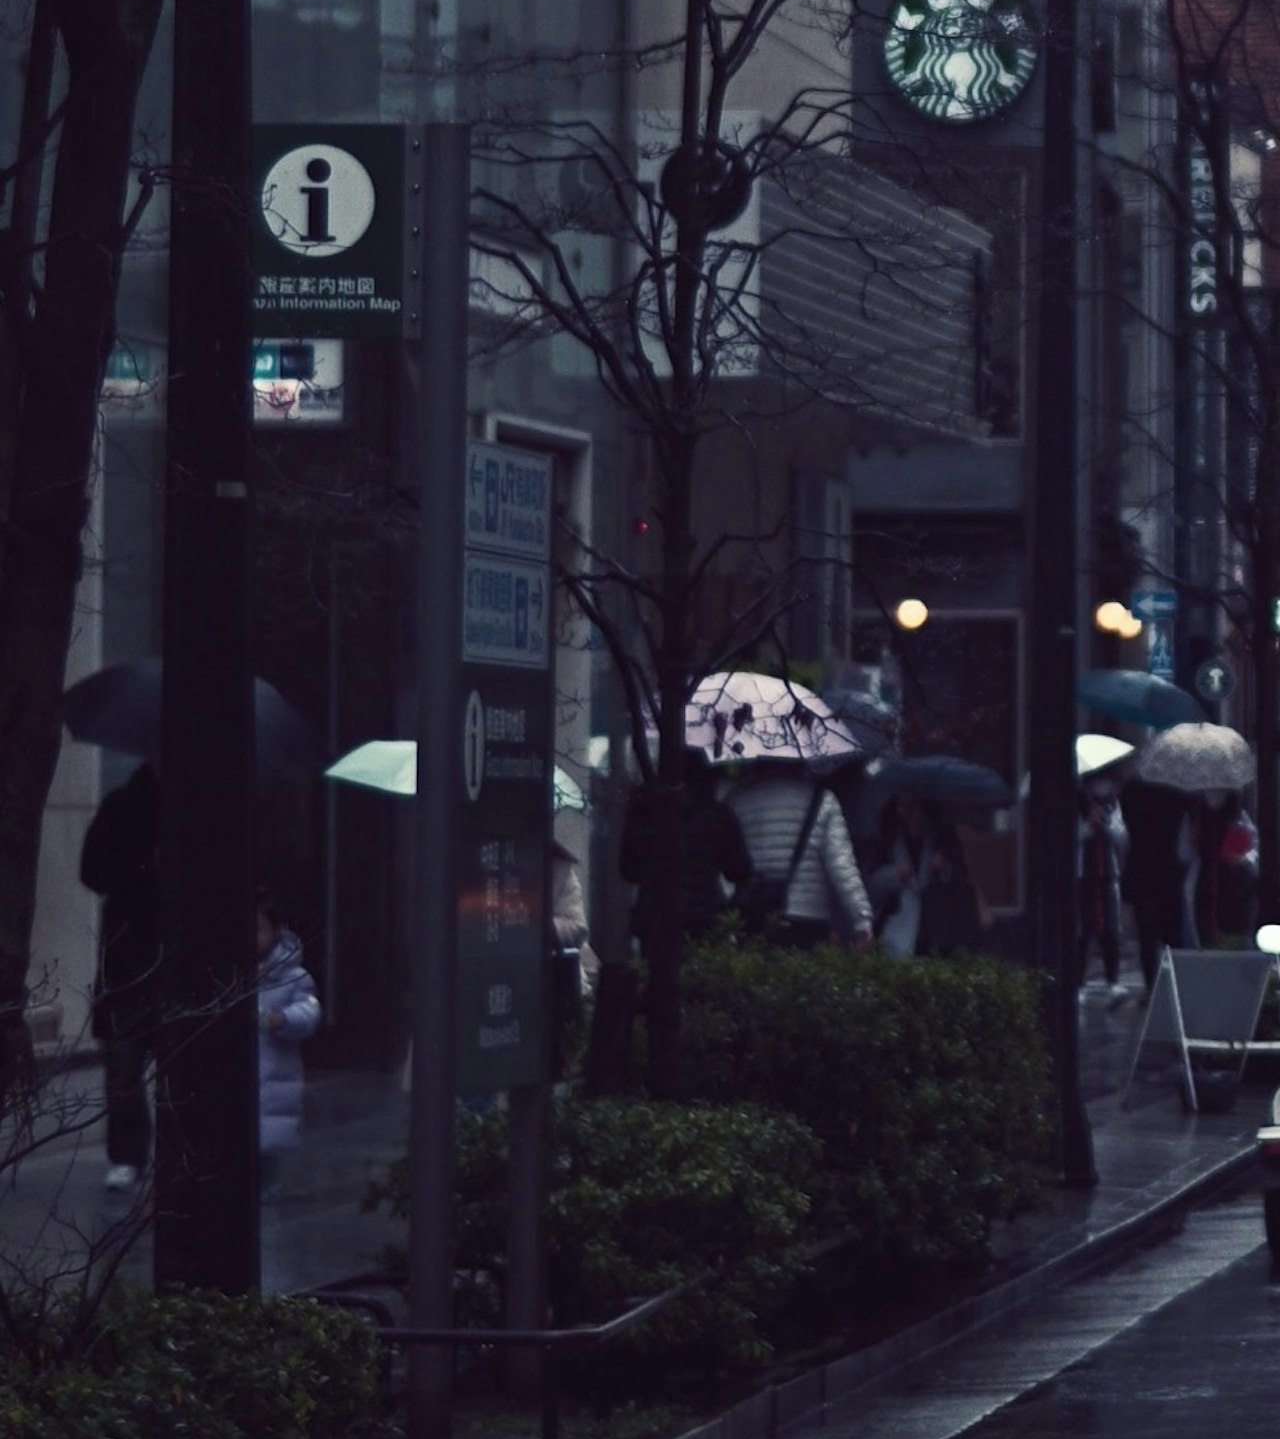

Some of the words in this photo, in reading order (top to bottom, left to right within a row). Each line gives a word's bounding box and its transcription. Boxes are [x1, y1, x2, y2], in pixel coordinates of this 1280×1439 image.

[1189, 82, 1219, 313] ARBUCKS
[280, 296, 366, 310] Information
[370, 296, 402, 313] Map
